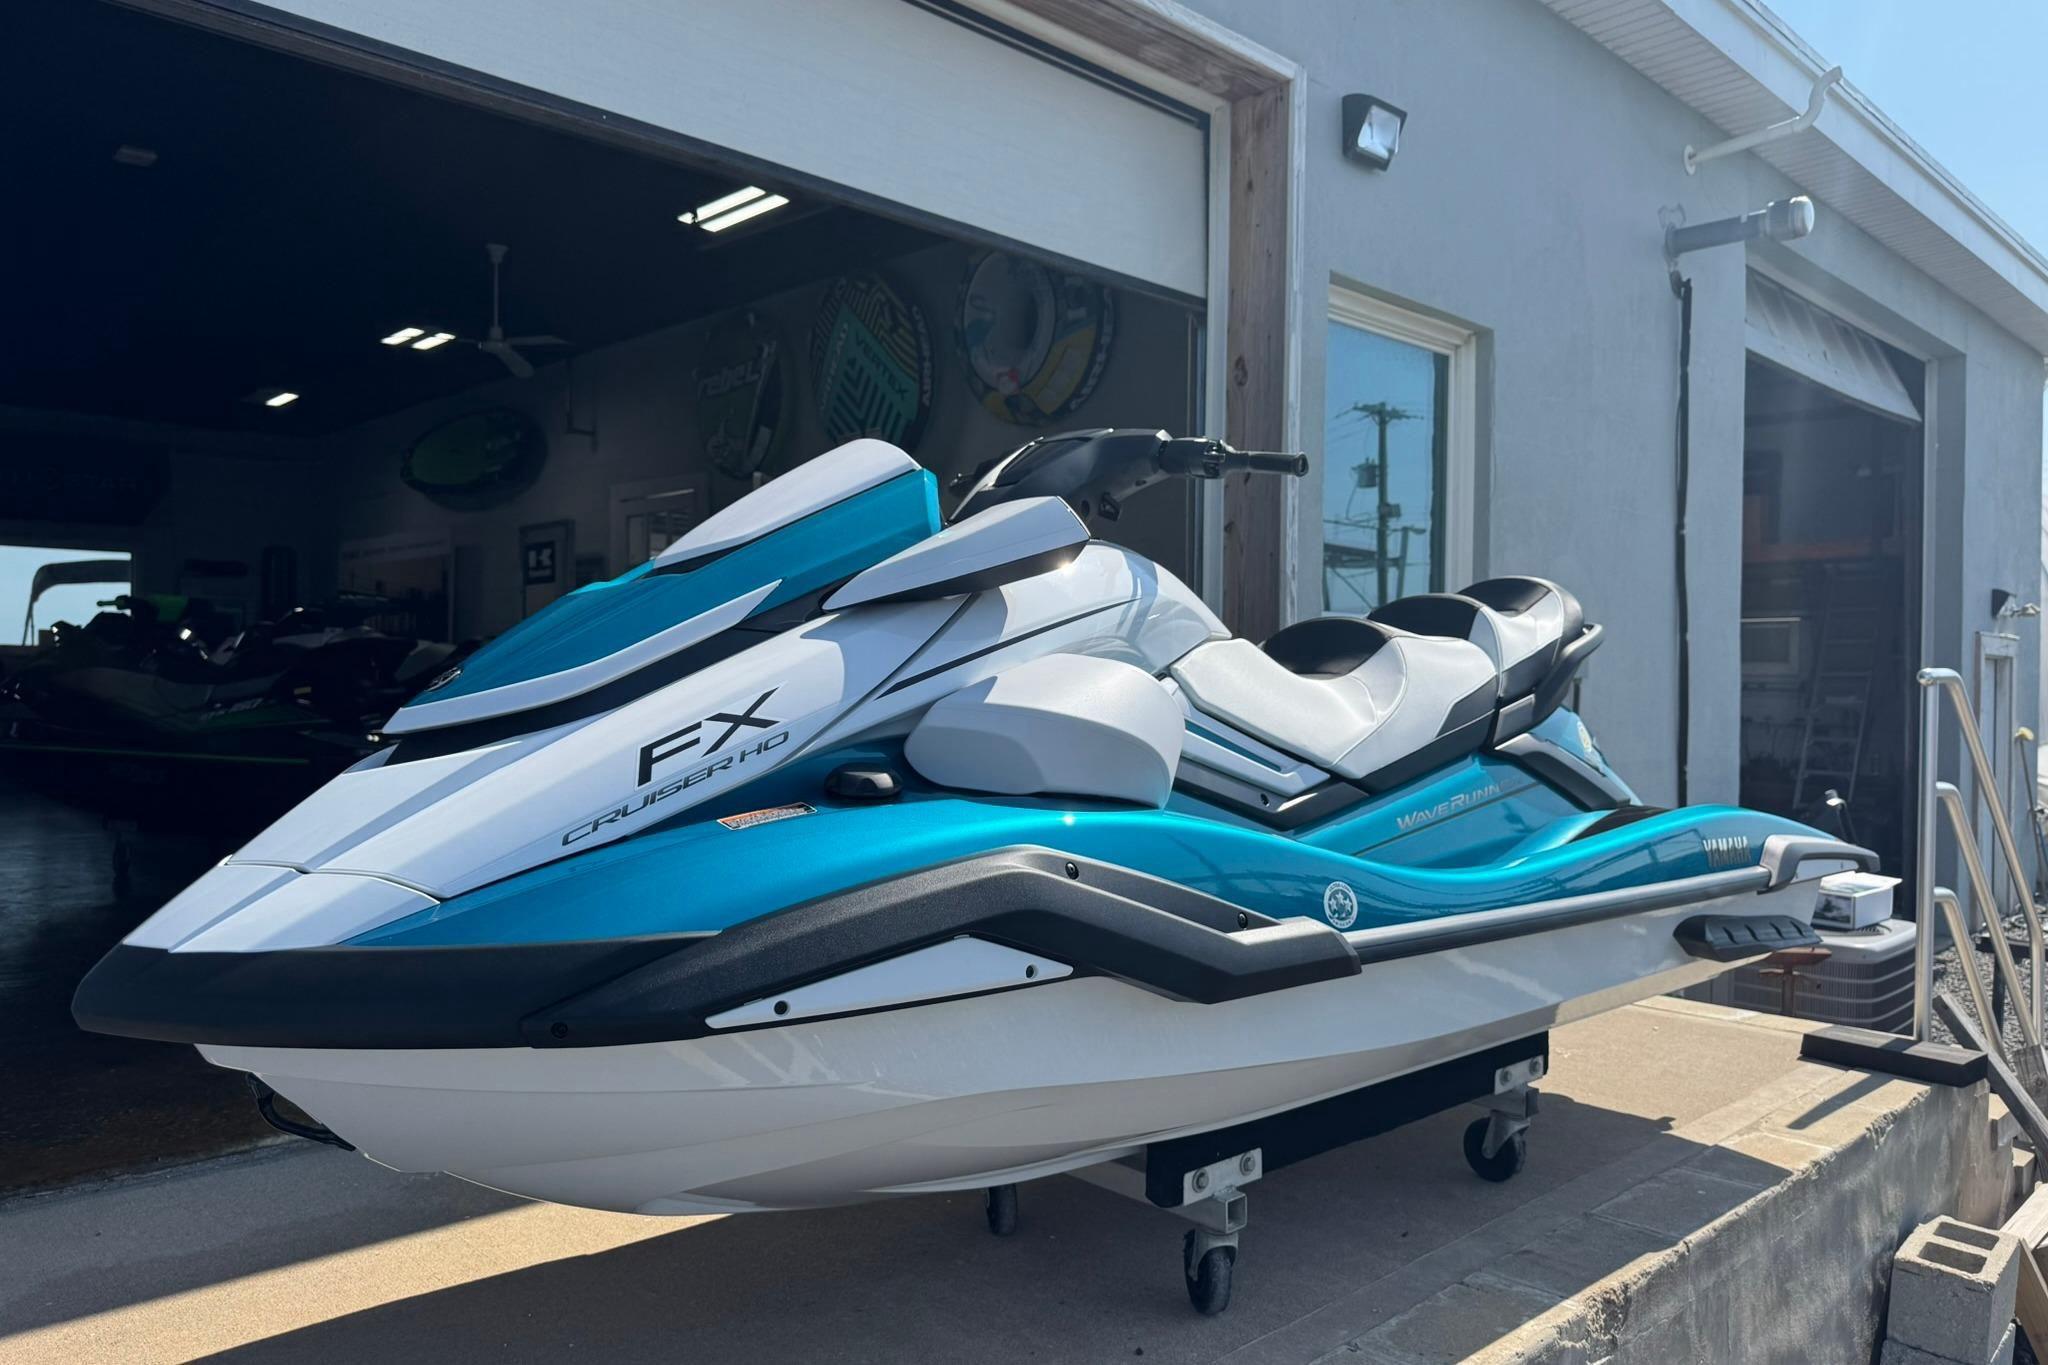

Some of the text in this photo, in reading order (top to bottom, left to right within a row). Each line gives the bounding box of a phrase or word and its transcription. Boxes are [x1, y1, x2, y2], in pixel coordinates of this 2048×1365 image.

[561, 755, 734, 846] CRUISER
[739, 730, 790, 763] HO
[637, 686, 781, 788] FX
